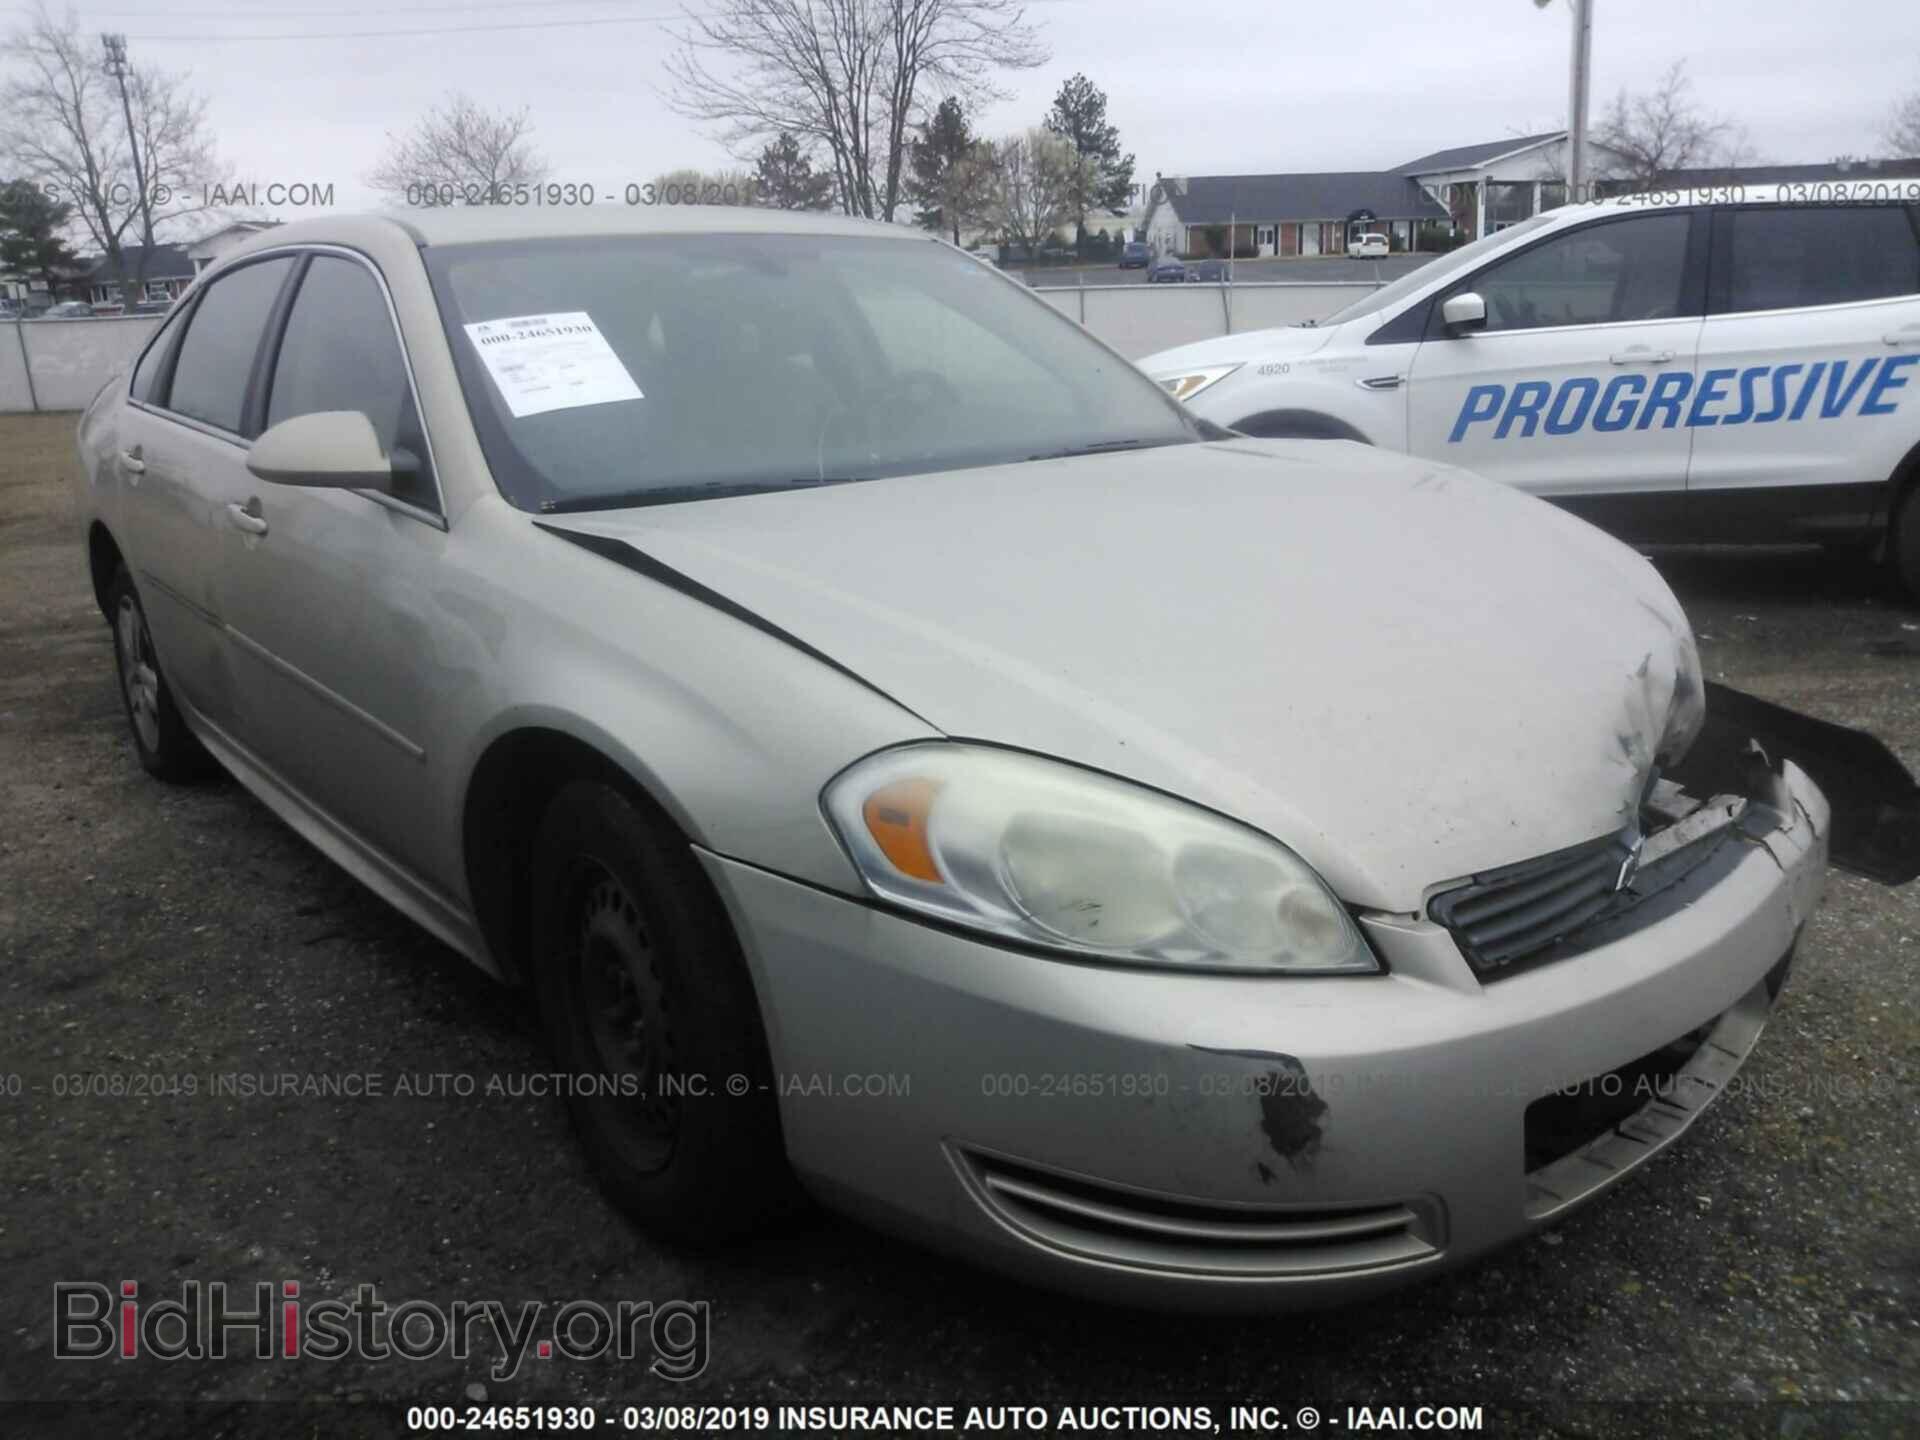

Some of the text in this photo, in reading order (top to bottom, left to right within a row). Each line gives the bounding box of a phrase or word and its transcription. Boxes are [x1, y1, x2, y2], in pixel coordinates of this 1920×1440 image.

[480, 325, 593, 346] 000-24651930
[1257, 363, 1290, 376] 4920
[1448, 354, 1919, 443] PROGRESSIVE
